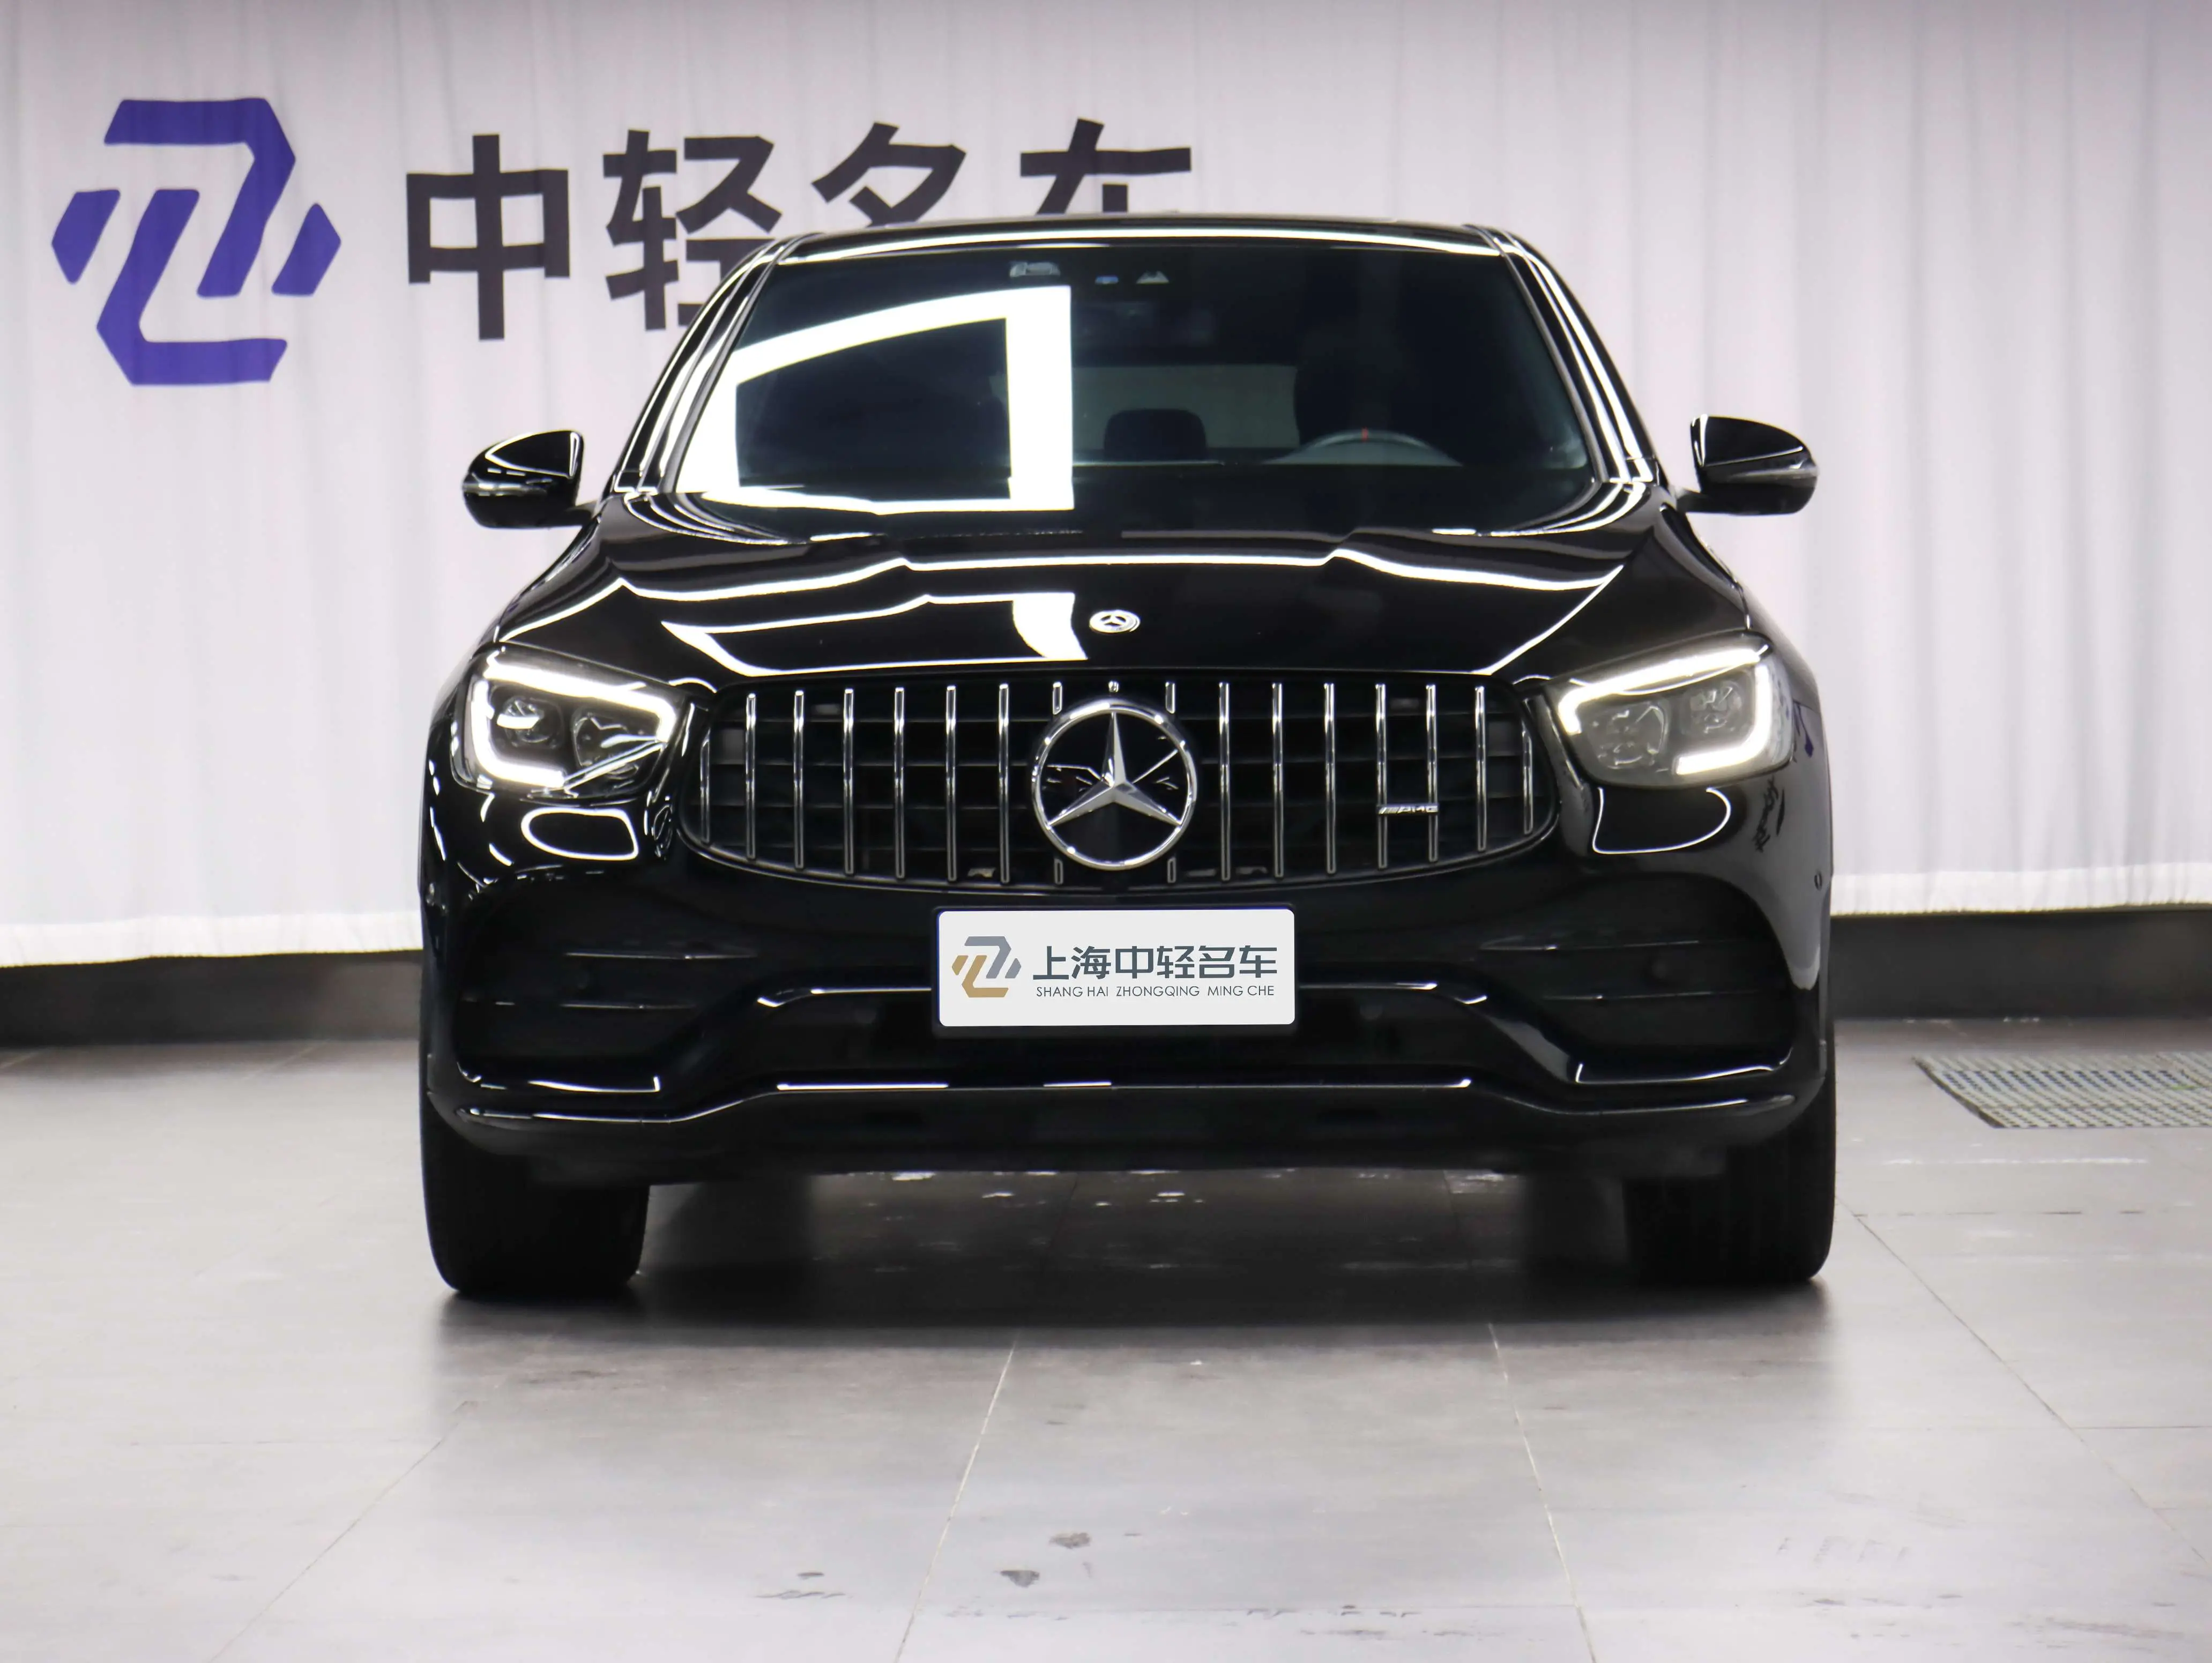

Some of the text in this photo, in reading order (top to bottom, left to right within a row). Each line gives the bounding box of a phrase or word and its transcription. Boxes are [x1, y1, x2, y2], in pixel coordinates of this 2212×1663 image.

[1032, 944, 1278, 980] 上海中轻名车
[1036, 985, 1275, 997] SHANG HAI ZHONGQING MING CHE
